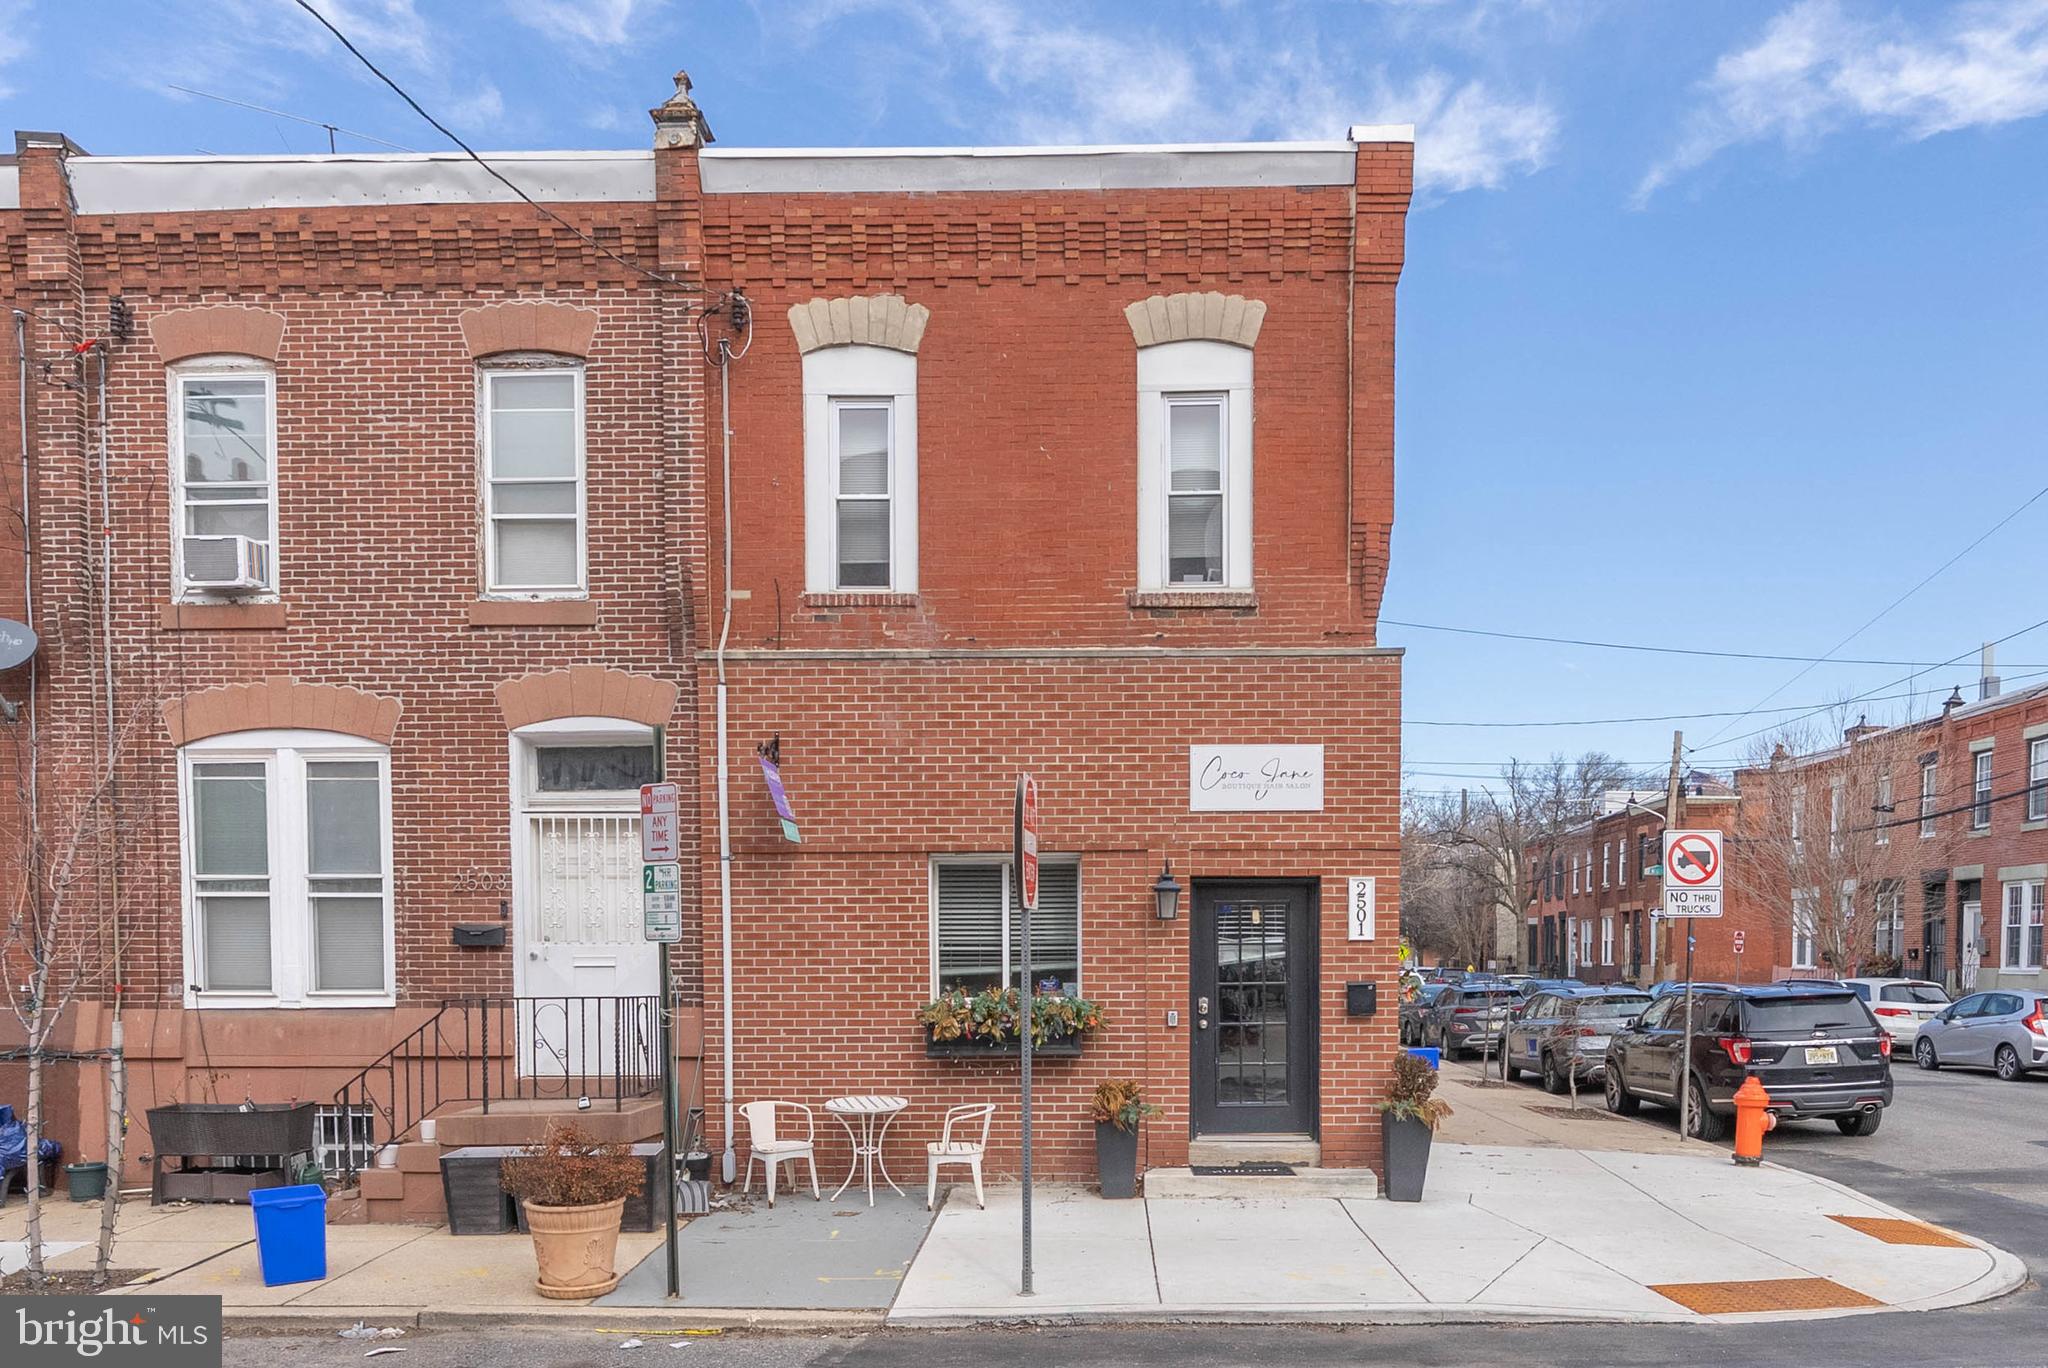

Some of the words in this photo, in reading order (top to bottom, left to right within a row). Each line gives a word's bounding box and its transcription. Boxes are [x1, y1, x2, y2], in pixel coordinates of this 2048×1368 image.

[1200, 755, 1250, 791] Coco
[1255, 757, 1314, 801] Jane
[1221, 783, 1261, 791] BOUTIQUE
[641, 793, 651, 808] NO
[653, 793, 675, 804] PARKING
[652, 816, 668, 828] ANY
[652, 830, 669, 842] TIME
[453, 870, 507, 891] 2503
[645, 869, 652, 889] 2
[655, 880, 678, 890] PARKING
[1670, 892, 1688, 903] NO
[1693, 895, 1717, 903] THRU
[1356, 881, 1367, 937] 2501
[1676, 905, 1712, 914] TRUCKS
